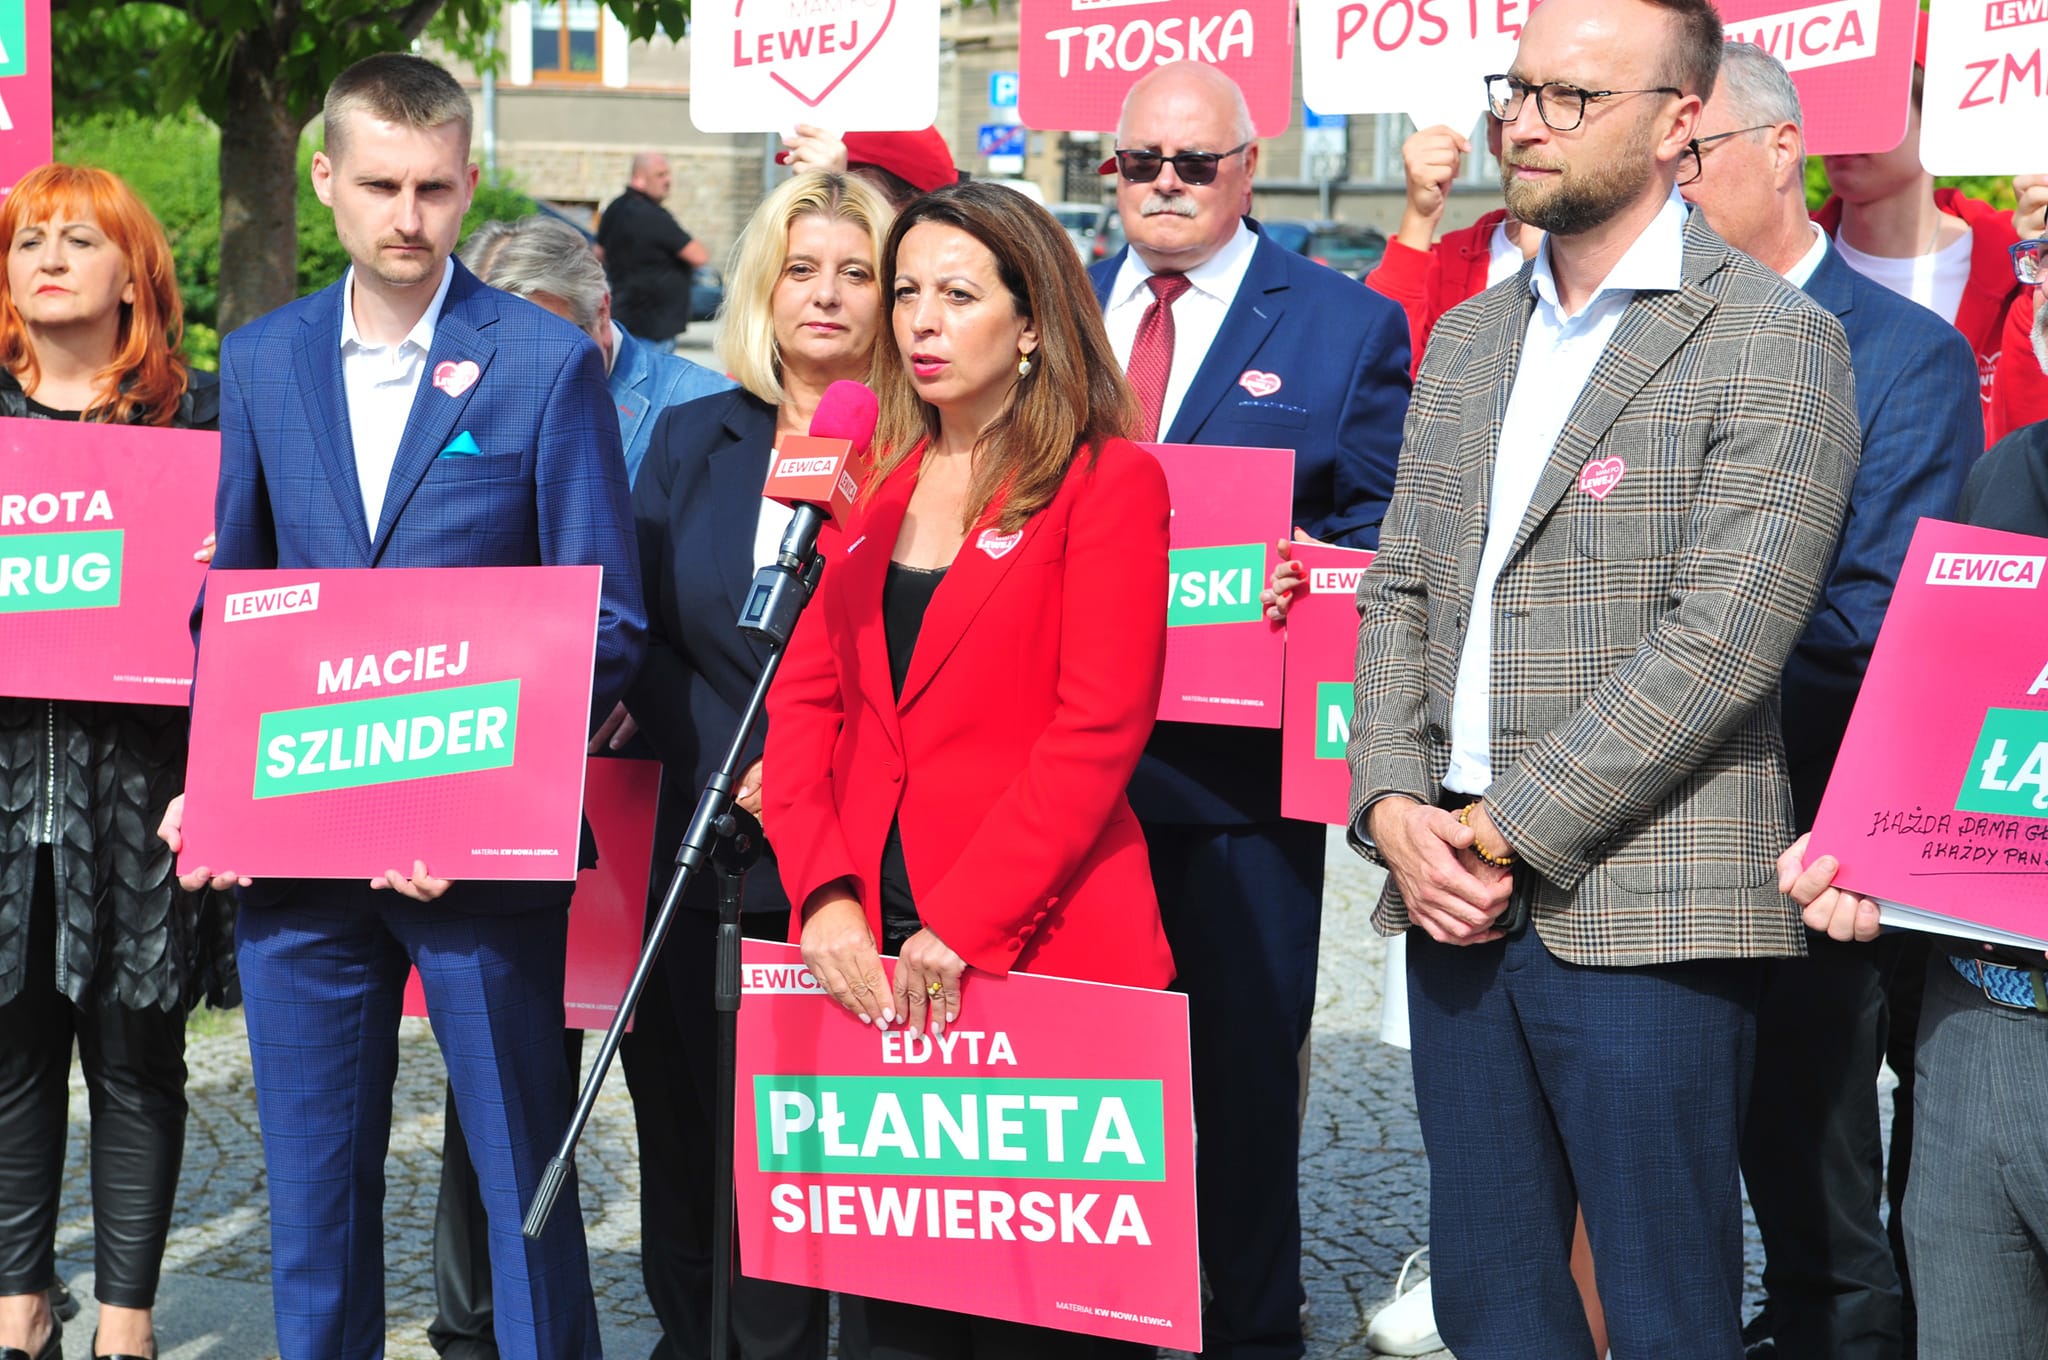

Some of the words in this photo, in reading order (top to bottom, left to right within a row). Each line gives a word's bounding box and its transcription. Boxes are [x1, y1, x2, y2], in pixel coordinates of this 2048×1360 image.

[733, 20, 858, 67] LEWEJ
[1045, 8, 1254, 78] TROSKA
[1336, 0, 1544, 60] POSTĘ
[1957, 48, 2048, 110] ZM
[780, 459, 832, 474] LEWICA
[0, 489, 114, 526] ROTA
[0, 552, 112, 597] RUG
[1316, 572, 1364, 589] LEW
[1934, 556, 2035, 584] LEWICA
[231, 588, 313, 617] LEWICA
[316, 640, 470, 695] MACIEJ
[265, 705, 509, 779] SZLINDER
[1958, 816, 2019, 840] DAMA
[741, 968, 823, 989] LEWIC
[881, 1030, 1018, 1066] EDYTA
[768, 1089, 1146, 1165] PŁANETA
[770, 1183, 1153, 1246] SIEWIERSKA
[1094, 1307, 1109, 1317] KW
[1110, 1310, 1138, 1322] NOWA
[1139, 1315, 1173, 1328] LEWICA
